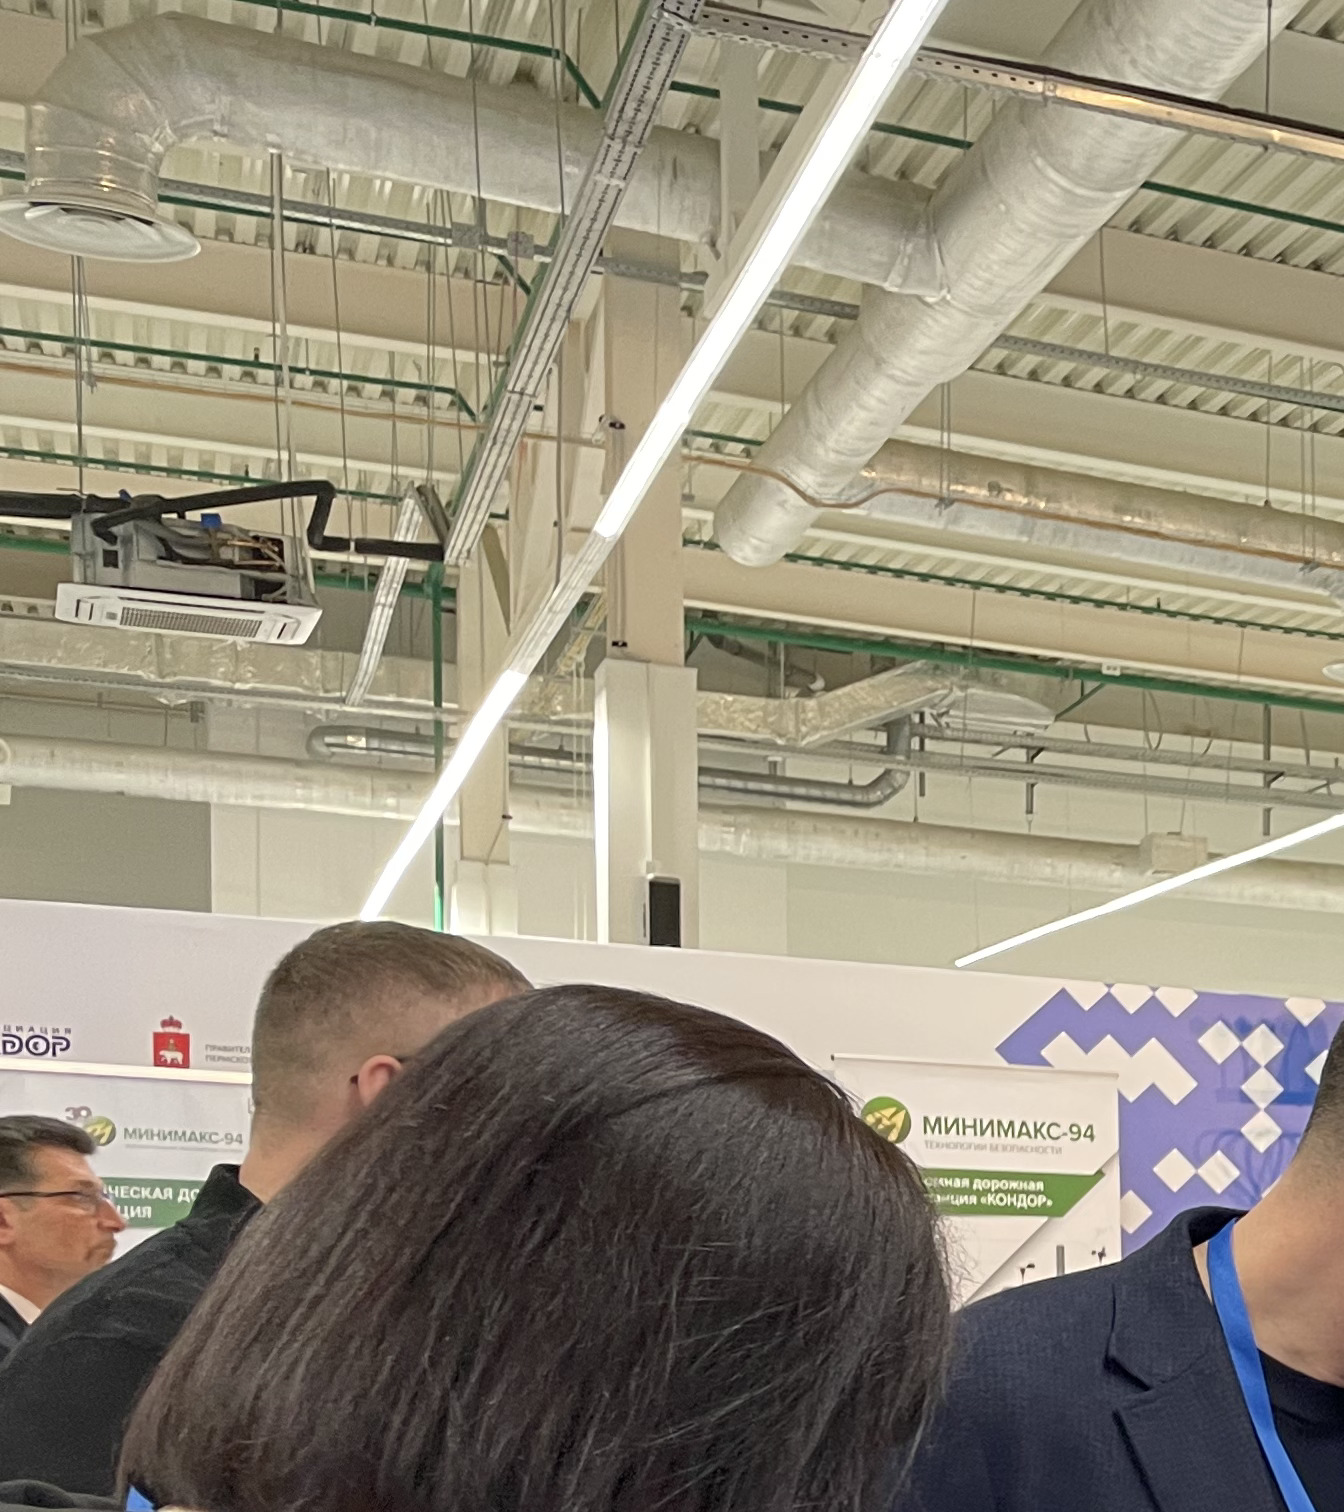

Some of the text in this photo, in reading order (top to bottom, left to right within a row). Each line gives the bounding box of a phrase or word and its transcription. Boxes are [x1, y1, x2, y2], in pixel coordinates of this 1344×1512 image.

[123, 1127, 243, 1145] МИНИМАКС-94
[923, 1115, 1096, 1143] МИНИМАКС-94
[972, 1177, 1045, 1192] дорожная
[177, 1187, 200, 1204] ДО
[980, 1192, 1054, 1210] «КОНДОР»
[117, 1204, 152, 1220] ЦИЯ
